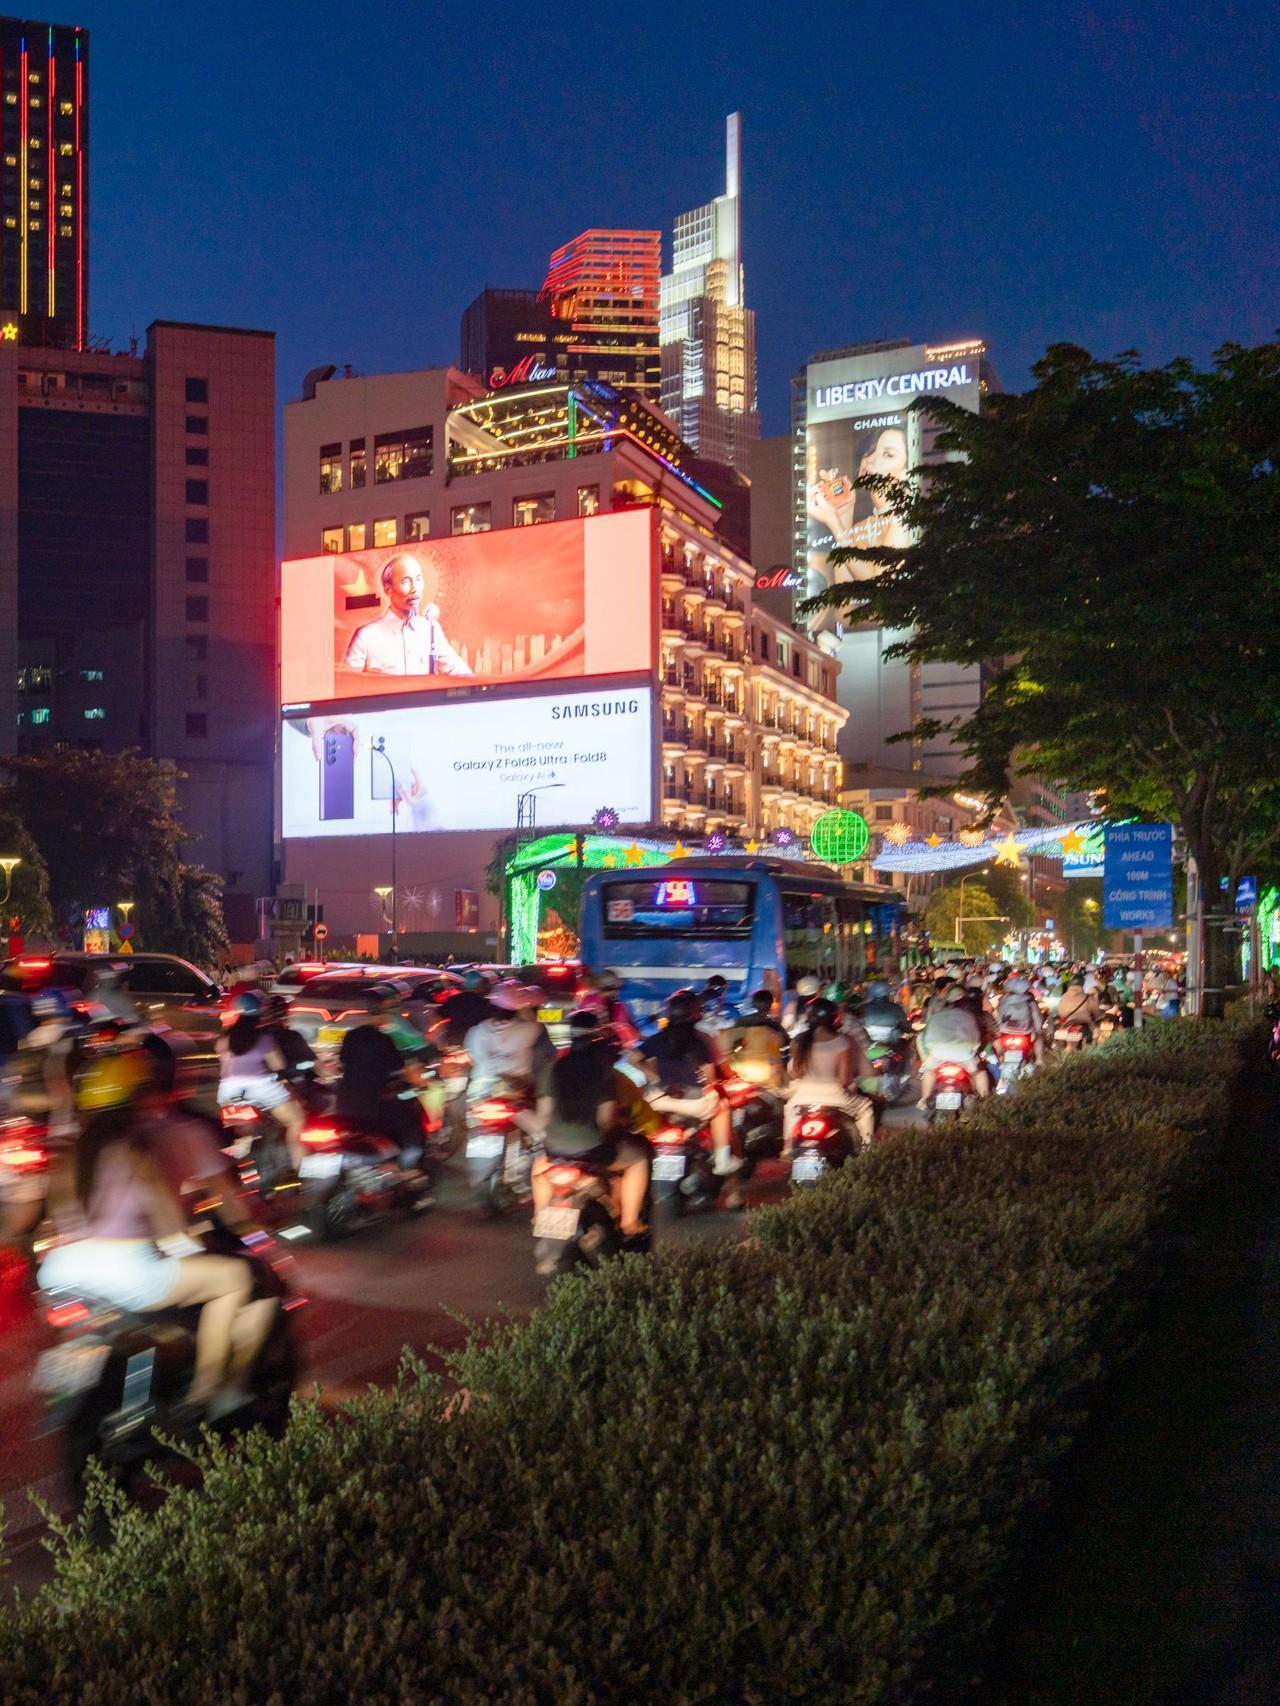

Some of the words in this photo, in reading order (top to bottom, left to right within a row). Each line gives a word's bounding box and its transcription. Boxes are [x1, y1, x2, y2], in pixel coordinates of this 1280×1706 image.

[816, 378, 886, 408] LIBERTY
[886, 365, 972, 395] CENTRAL
[853, 415, 901, 431] CHANEL
[551, 700, 639, 720] SAMSUNG
[494, 743, 515, 754] The
[517, 740, 564, 753] all-new
[453, 760, 494, 772] Galaxy
[495, 758, 502, 768] Z
[504, 756, 537, 768] Fold8
[539, 754, 567, 766] Ultra
[573, 752, 607, 764] Fold8
[499, 772, 534, 783] Galaxy
[1121, 850, 1154, 862] AHEAD
[1126, 871, 1149, 881] 100M
[1120, 909, 1155, 921] WORKS
